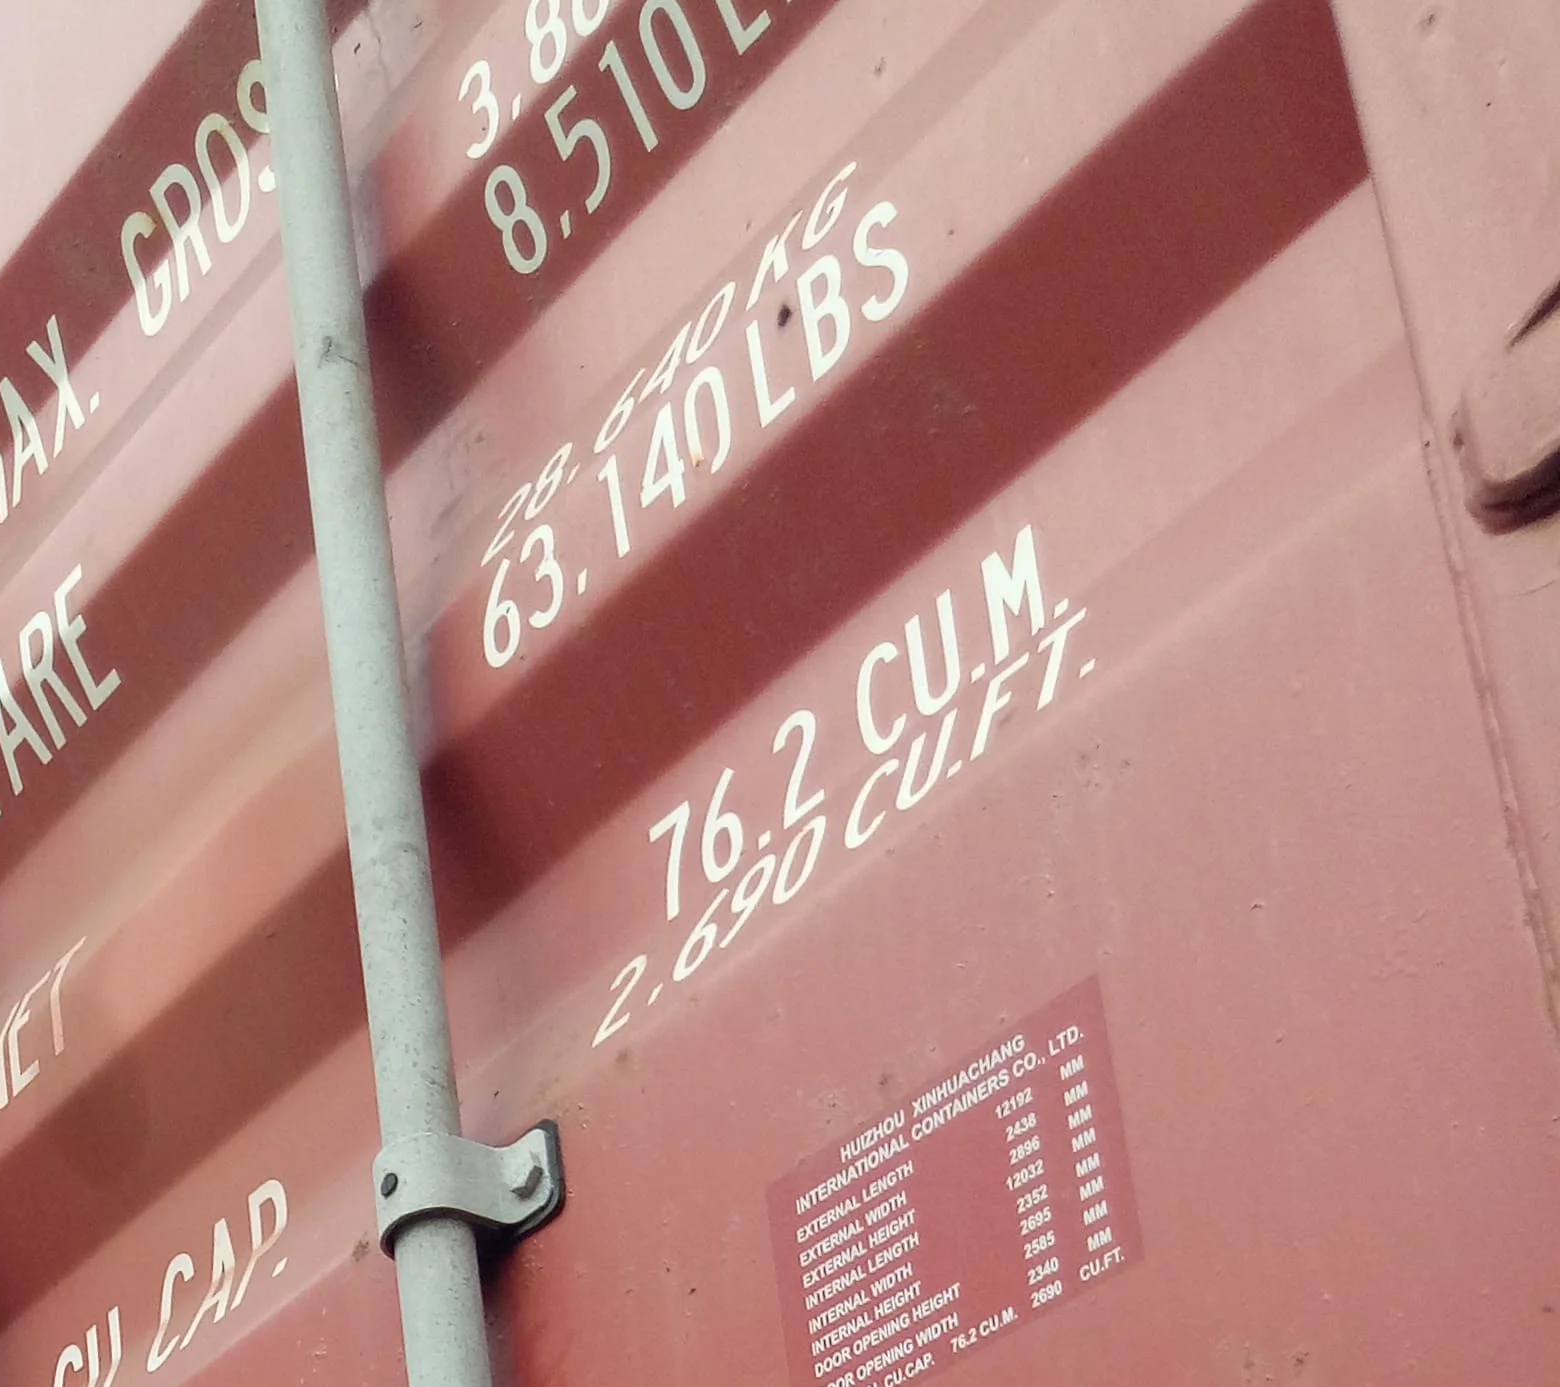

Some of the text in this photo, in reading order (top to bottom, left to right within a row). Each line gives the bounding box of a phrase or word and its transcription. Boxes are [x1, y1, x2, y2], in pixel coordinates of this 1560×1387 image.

[484, 0, 706, 274] 8,510
[481, 162, 857, 567] 28,640 KG
[483, 201, 910, 669] 63,140 LBS
[649, 710, 825, 921] 76.2
[590, 815, 827, 1049] 2,690
[796, 1025, 1084, 1214] INTERNATIONAL CONTAINERS CO., LTD.
[796, 1055, 1084, 1243] EXTERNAL LENGTH 12192 MM
[799, 1081, 1088, 1266] EXTERNAL WIDTH 2438 MM
[841, 1034, 1025, 1162] HUIZHOU XINHUACHANG
[147, 1178, 289, 1373] CAP.
[802, 1105, 1092, 1289] EXTERNAL HEIGHT 2896 MM
[805, 1127, 1096, 1310] INTERNAL LENGTH 12032 MM
[808, 1153, 1100, 1334] INTERNAL WIDTH 2352 MM
[811, 1176, 1104, 1357] INTERNAL HEIGHT 2695 MM
[814, 1200, 1108, 1378] DOOR OPENING HEIGHT 2585 MM
[857, 1340, 914, 1381] OPENING
[916, 1312, 959, 1348] WIDTH
[1027, 1257, 1059, 1286] 2340
[1087, 1227, 1112, 1252] MM
[950, 1327, 977, 1353] 76.2
[979, 1306, 1019, 1337] CU.M.
[1031, 1280, 1062, 1308] 2690
[1079, 1247, 1125, 1283] CU.FT.
